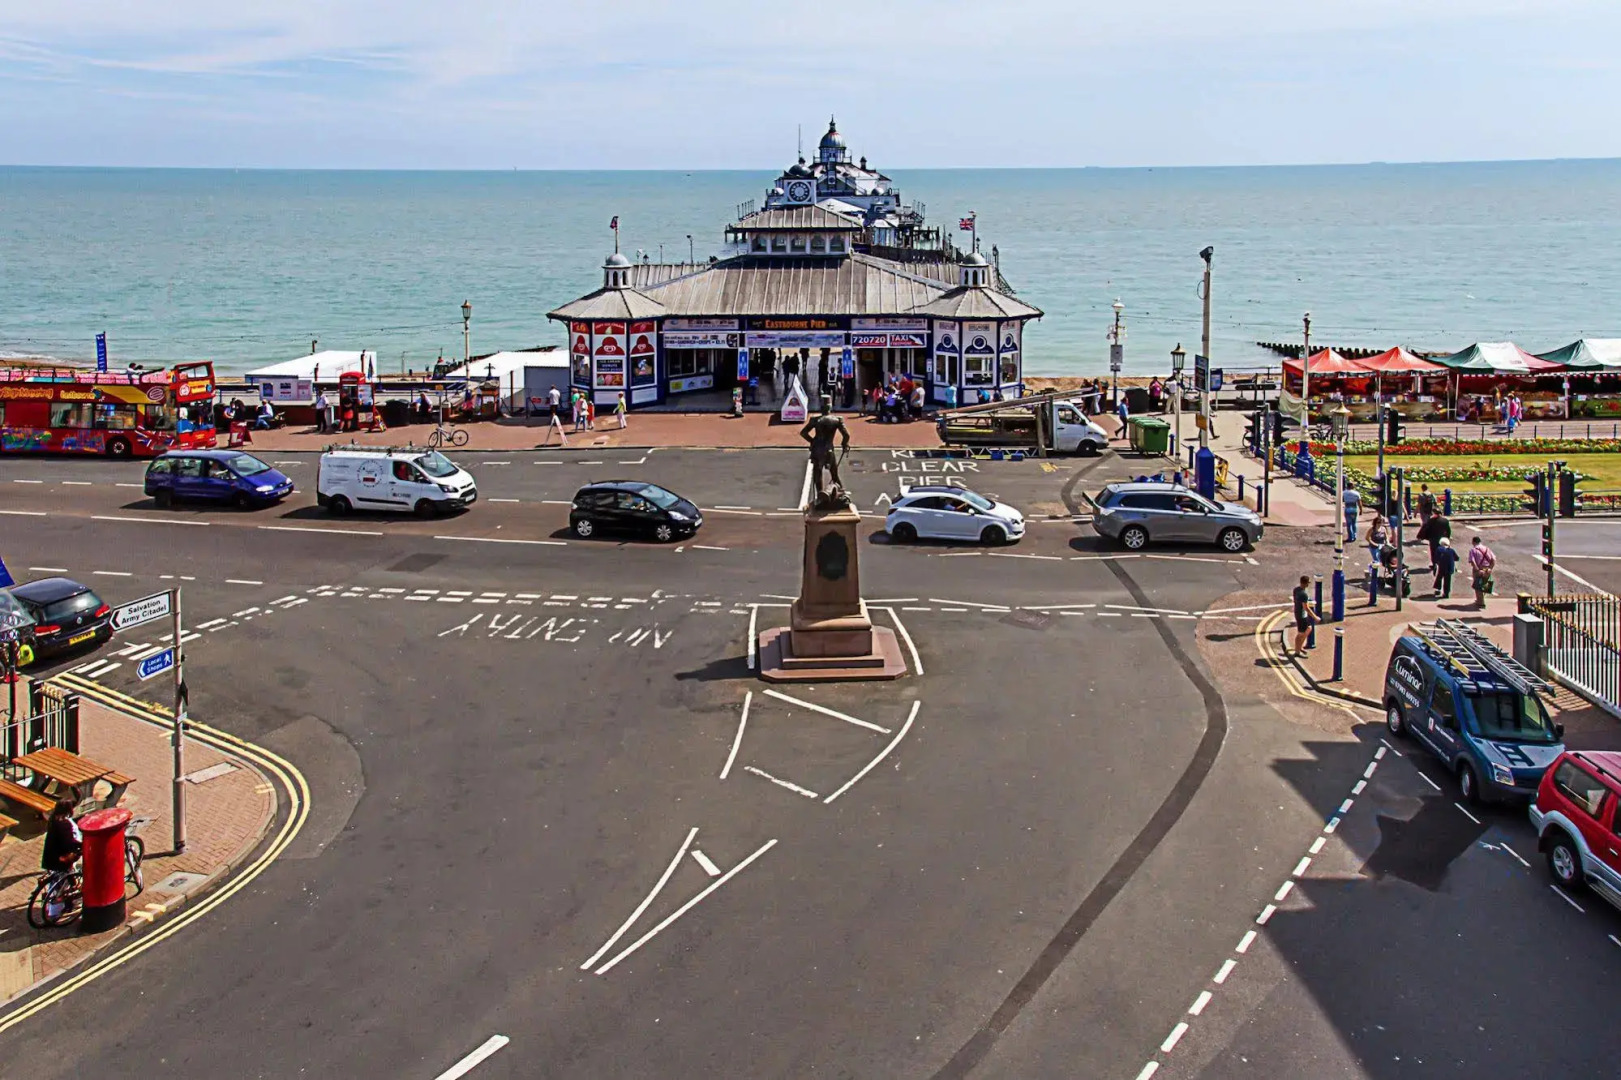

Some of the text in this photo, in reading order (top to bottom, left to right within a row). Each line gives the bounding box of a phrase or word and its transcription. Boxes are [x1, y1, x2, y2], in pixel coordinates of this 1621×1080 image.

[765, 319, 808, 328] EASTBOURNE
[811, 319, 826, 328] PIER
[882, 460, 980, 473] CLEAR
[898, 475, 968, 488] PIER
[128, 600, 161, 615] Salvation
[121, 604, 167, 625] Army Citadel
[147, 656, 162, 667] Local
[146, 663, 163, 674] Shops
